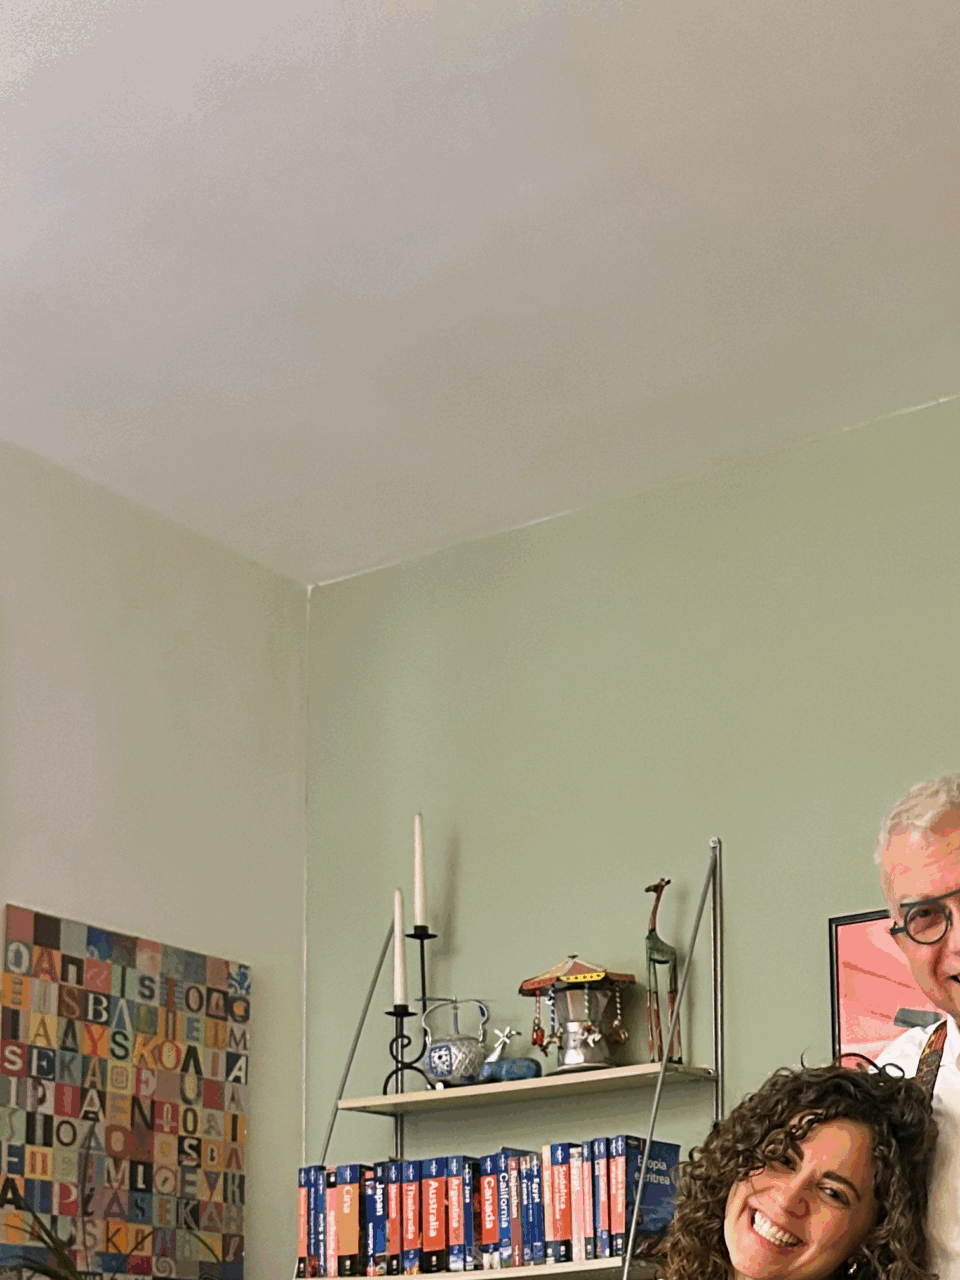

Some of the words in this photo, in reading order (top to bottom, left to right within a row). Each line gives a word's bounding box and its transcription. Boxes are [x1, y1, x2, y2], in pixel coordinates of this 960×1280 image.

[637, 1154, 667, 1171] Eopia
[343, 1186, 352, 1213] Cina
[374, 1182, 384, 1215] Japan
[407, 1184, 415, 1239] Thailandia
[428, 1181, 439, 1237] Australia
[451, 1179, 460, 1227] Argentina
[484, 1177, 495, 1229] Canada
[500, 1173, 509, 1228] California
[532, 1178, 540, 1202] Egypt
